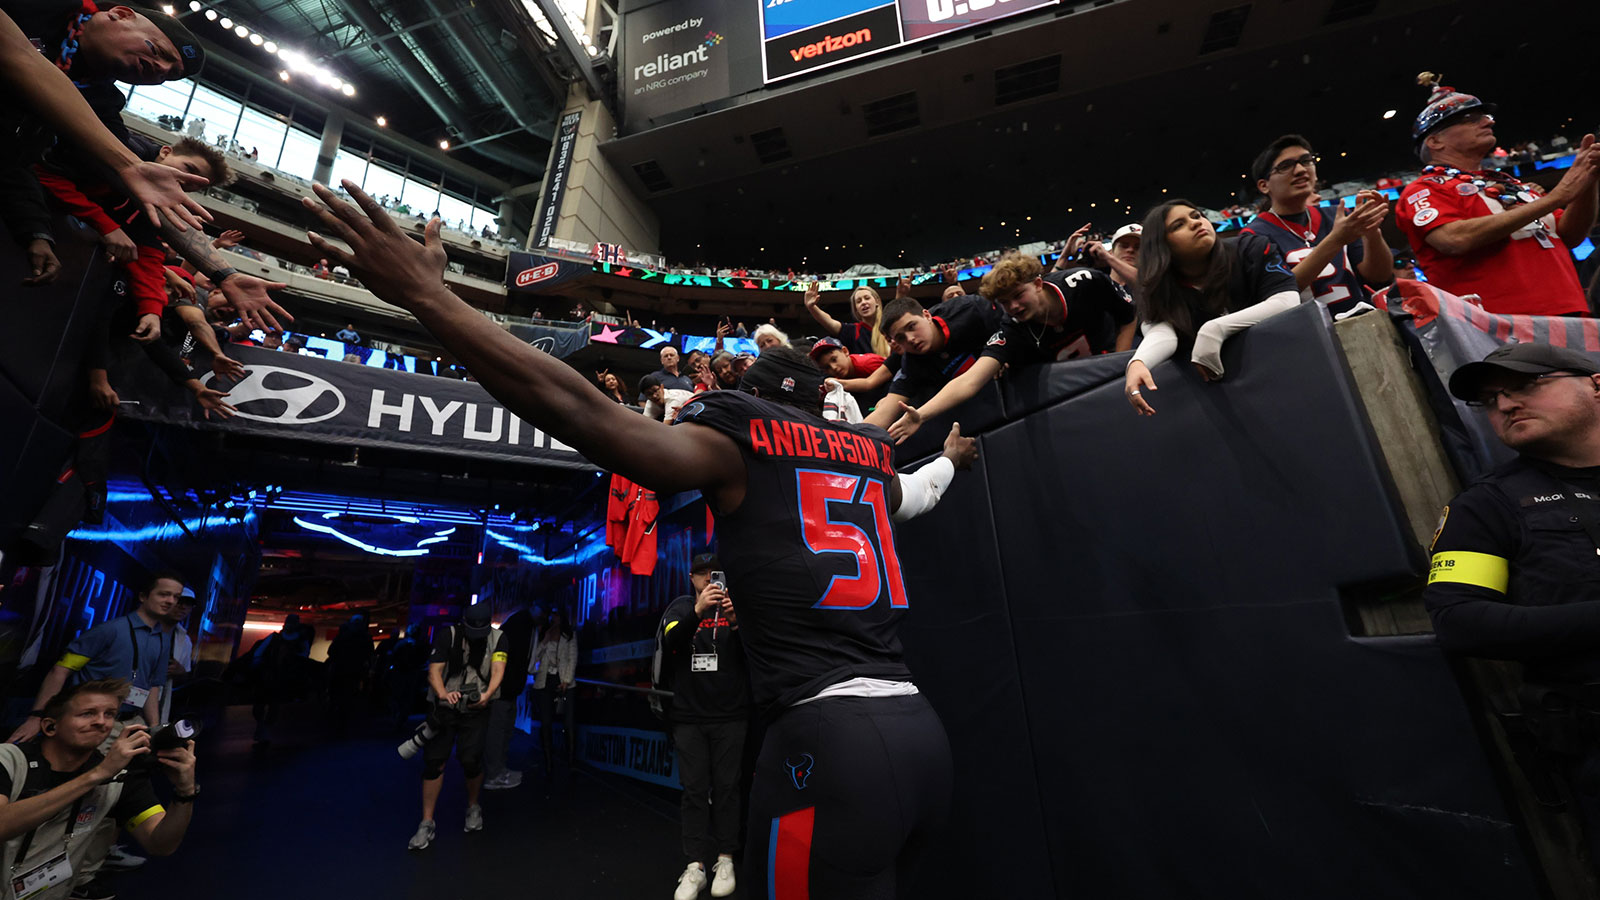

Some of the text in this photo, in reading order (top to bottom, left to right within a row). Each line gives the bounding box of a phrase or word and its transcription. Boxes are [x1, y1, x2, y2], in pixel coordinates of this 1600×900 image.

[642, 17, 703, 43] powered by
[790, 27, 872, 62] verizon
[634, 44, 709, 80] reliant
[634, 69, 709, 95] an NRG company
[367, 389, 579, 452] HYUN
[750, 418, 880, 469] ANDERSON
[795, 467, 910, 609] 51
[1445, 559, 1455, 568] 18
[629, 735, 674, 778] TEXANS
